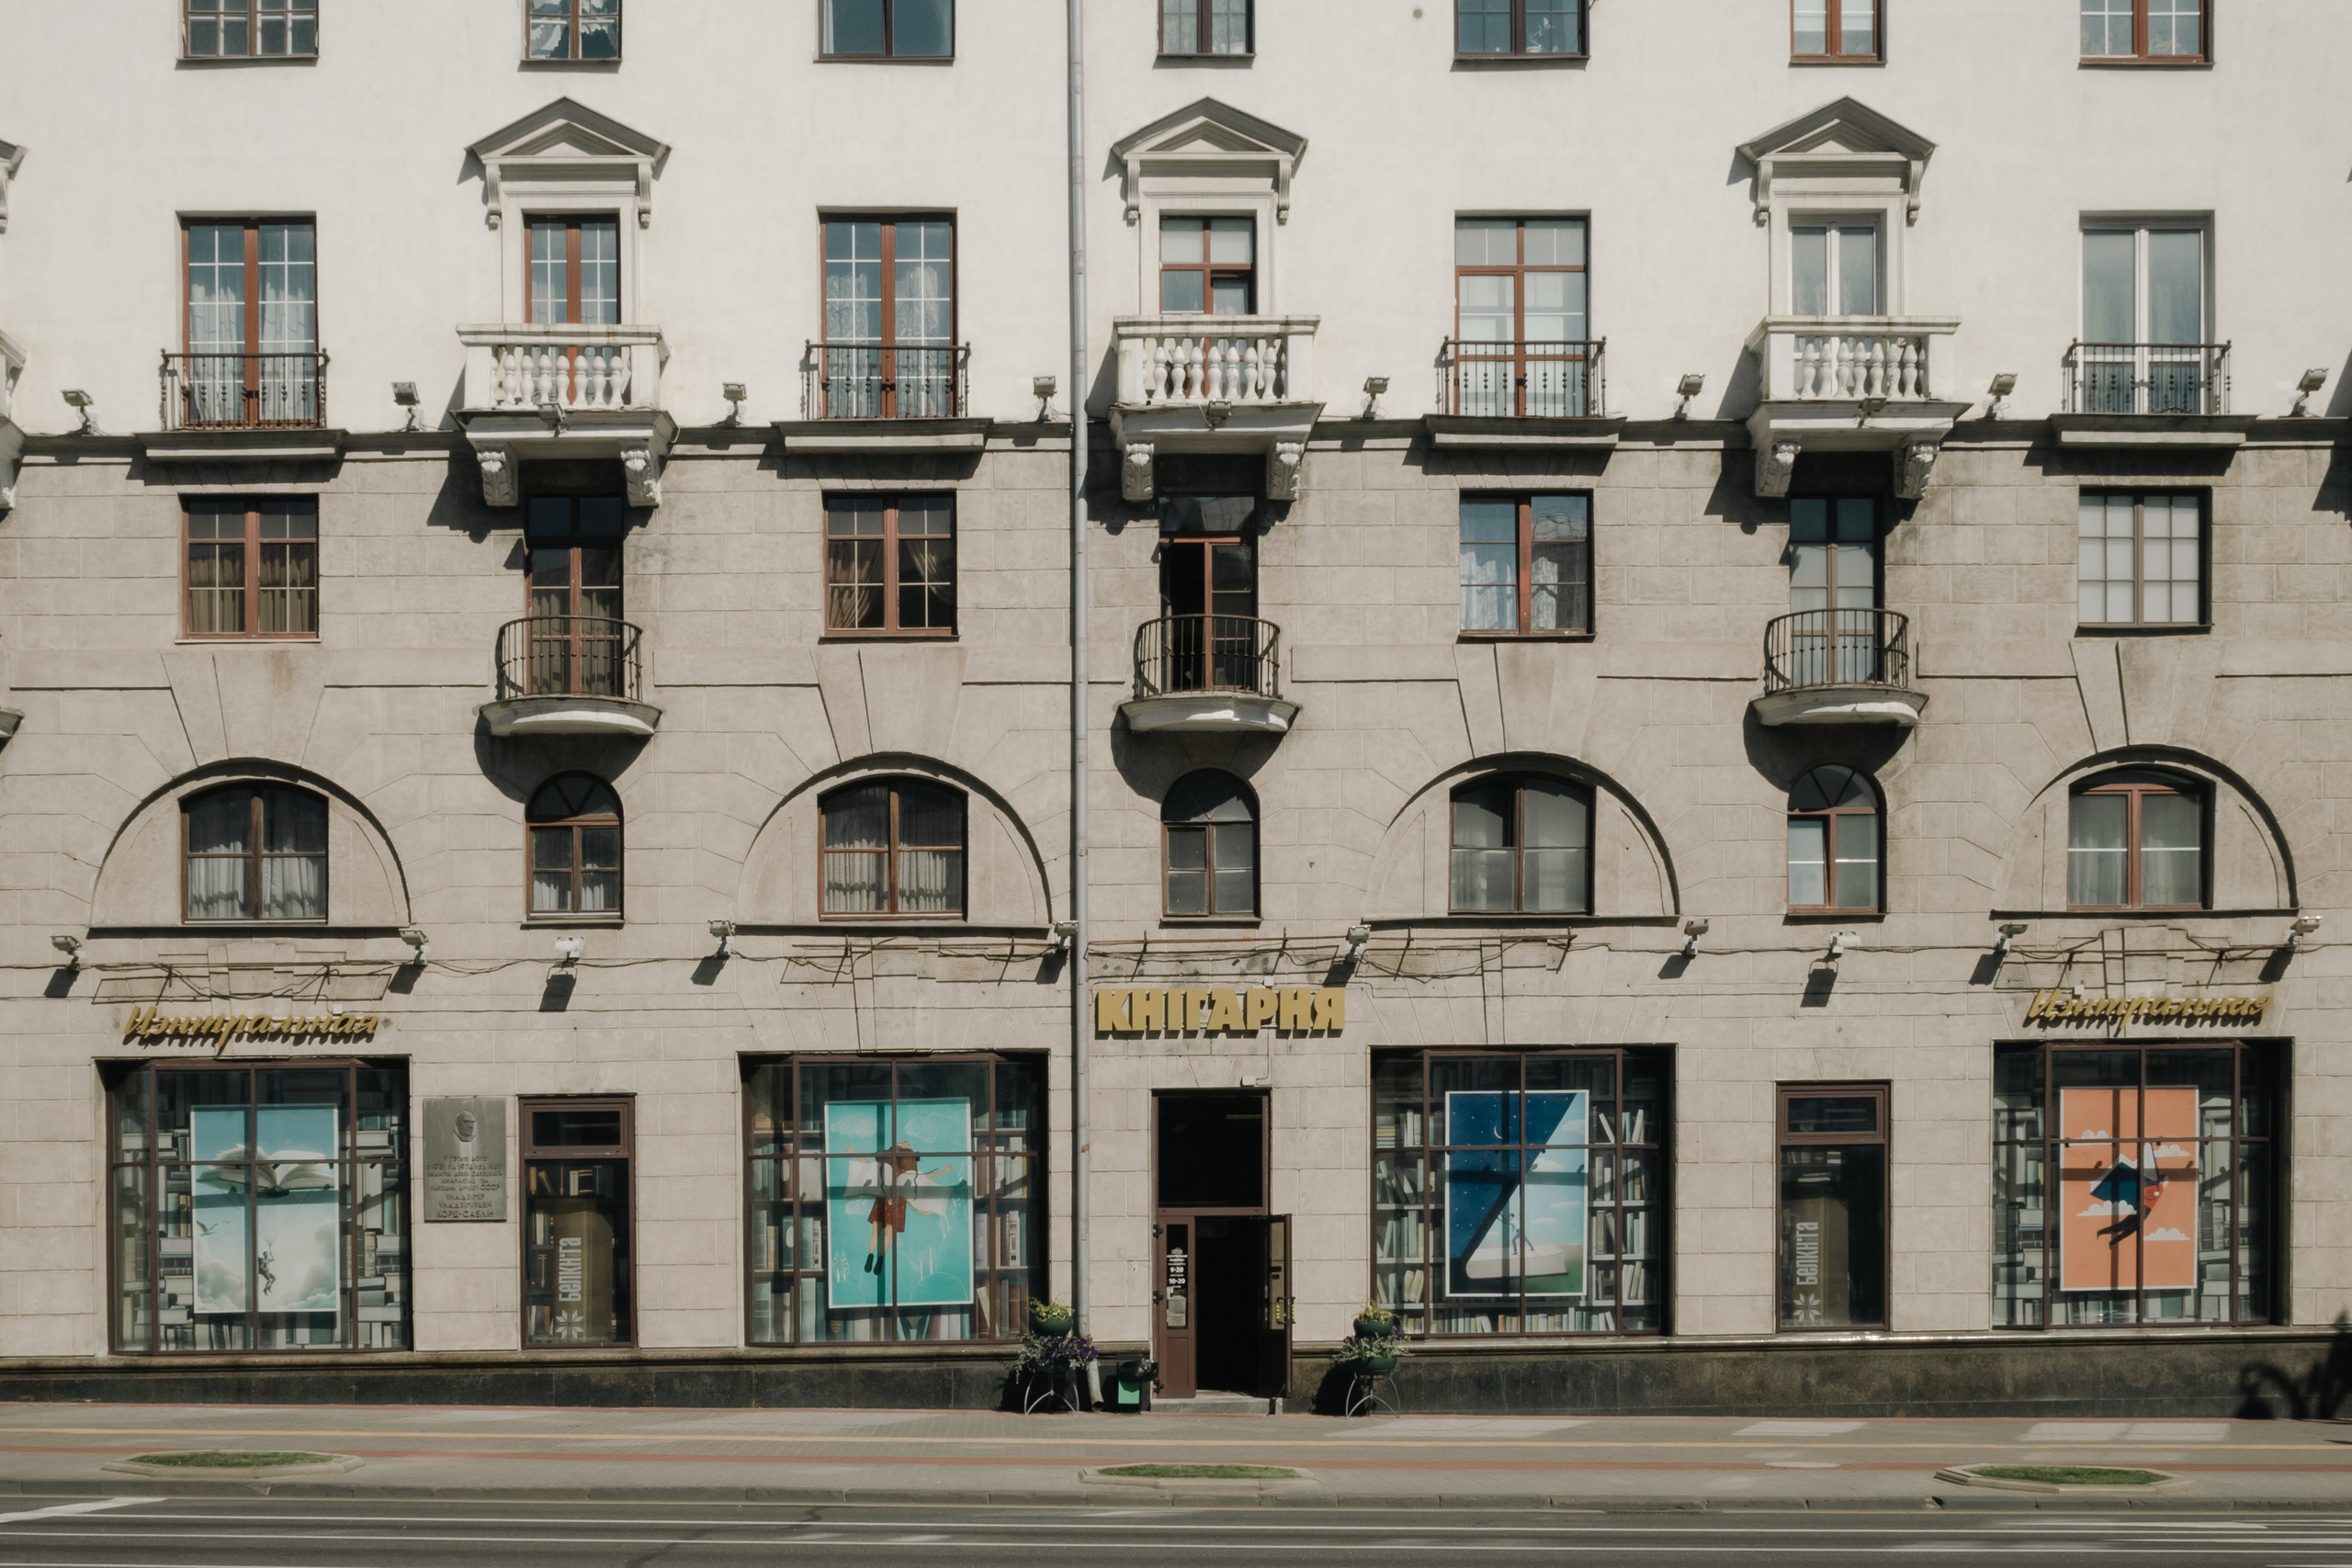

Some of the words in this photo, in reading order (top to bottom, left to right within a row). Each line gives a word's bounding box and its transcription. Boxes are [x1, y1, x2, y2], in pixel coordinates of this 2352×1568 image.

[123, 1005, 379, 1047] Цэнтральная
[1097, 987, 1346, 1032] КНІГАРНЯ
[2027, 988, 2273, 1031] Цэнтральная
